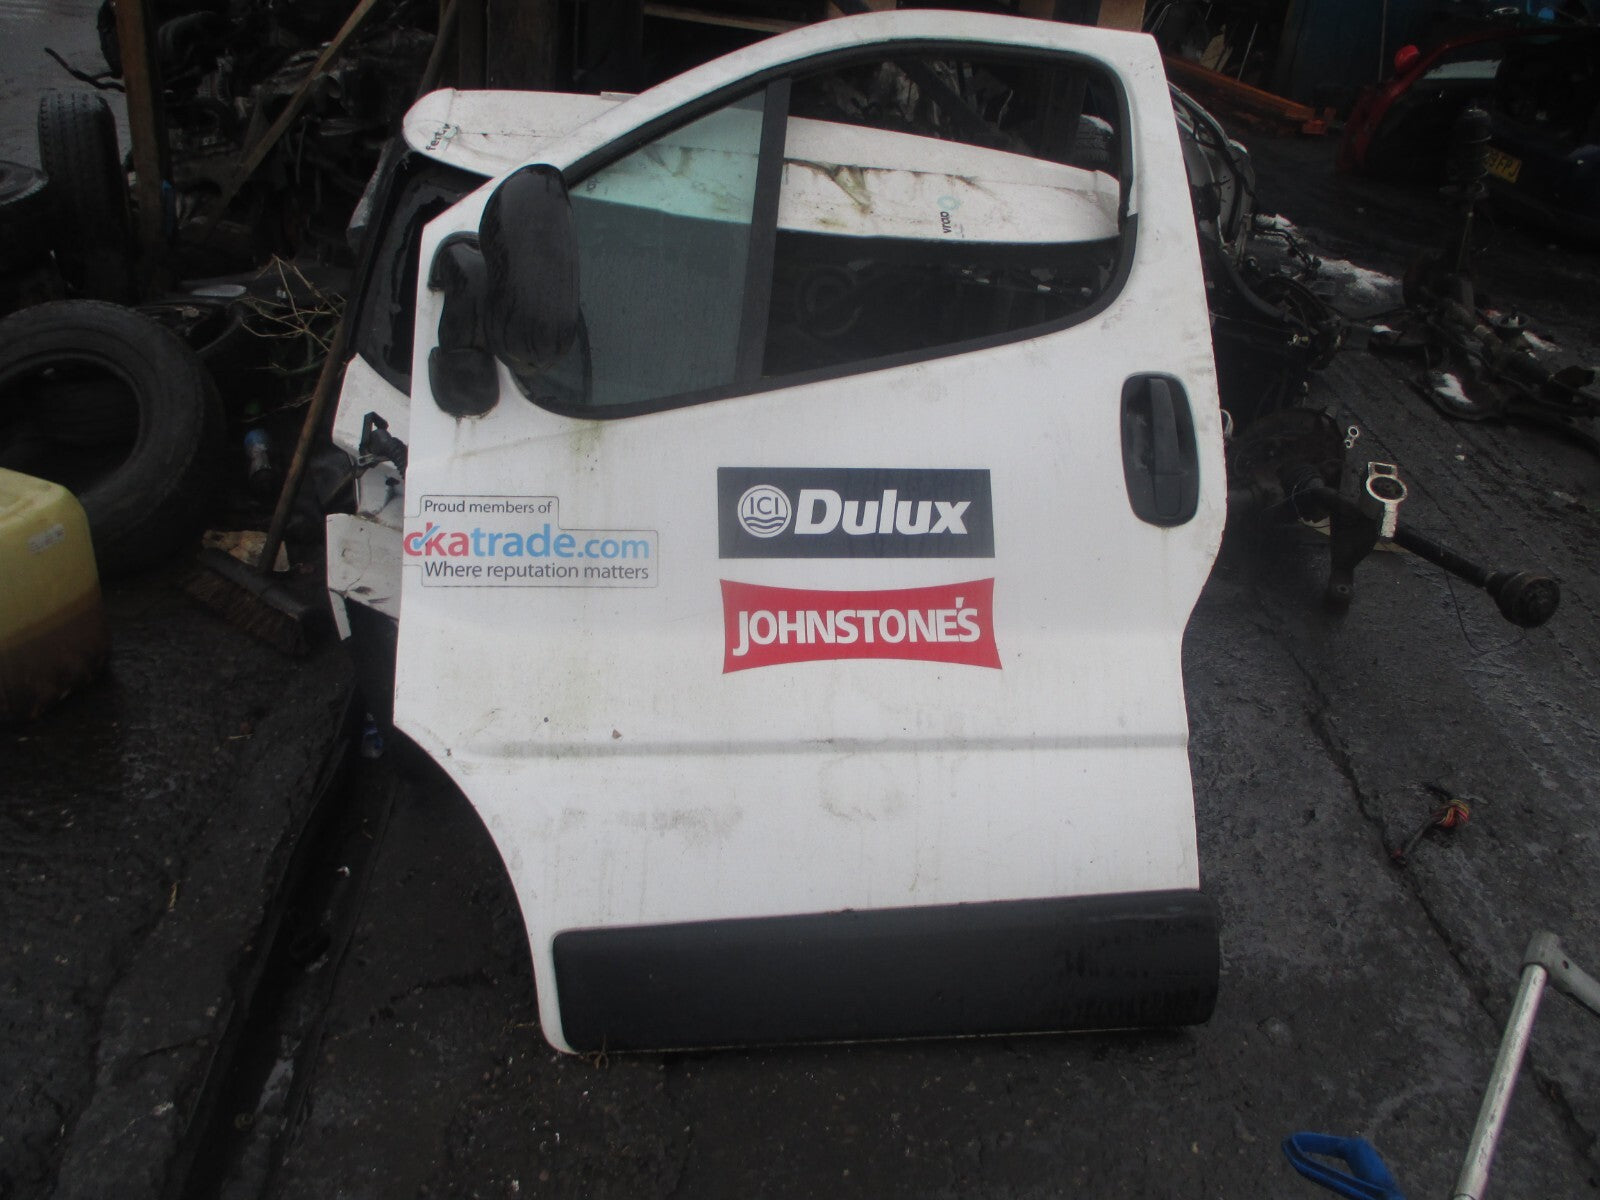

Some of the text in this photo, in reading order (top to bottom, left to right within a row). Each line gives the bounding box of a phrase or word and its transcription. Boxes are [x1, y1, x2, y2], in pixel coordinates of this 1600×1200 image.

[424, 500, 552, 513] Proud members of
[750, 496, 779, 514] ICI
[794, 489, 971, 535] Dulux
[425, 561, 649, 581] Where reputation matters
[733, 597, 980, 656] JOHNSTONE'S
